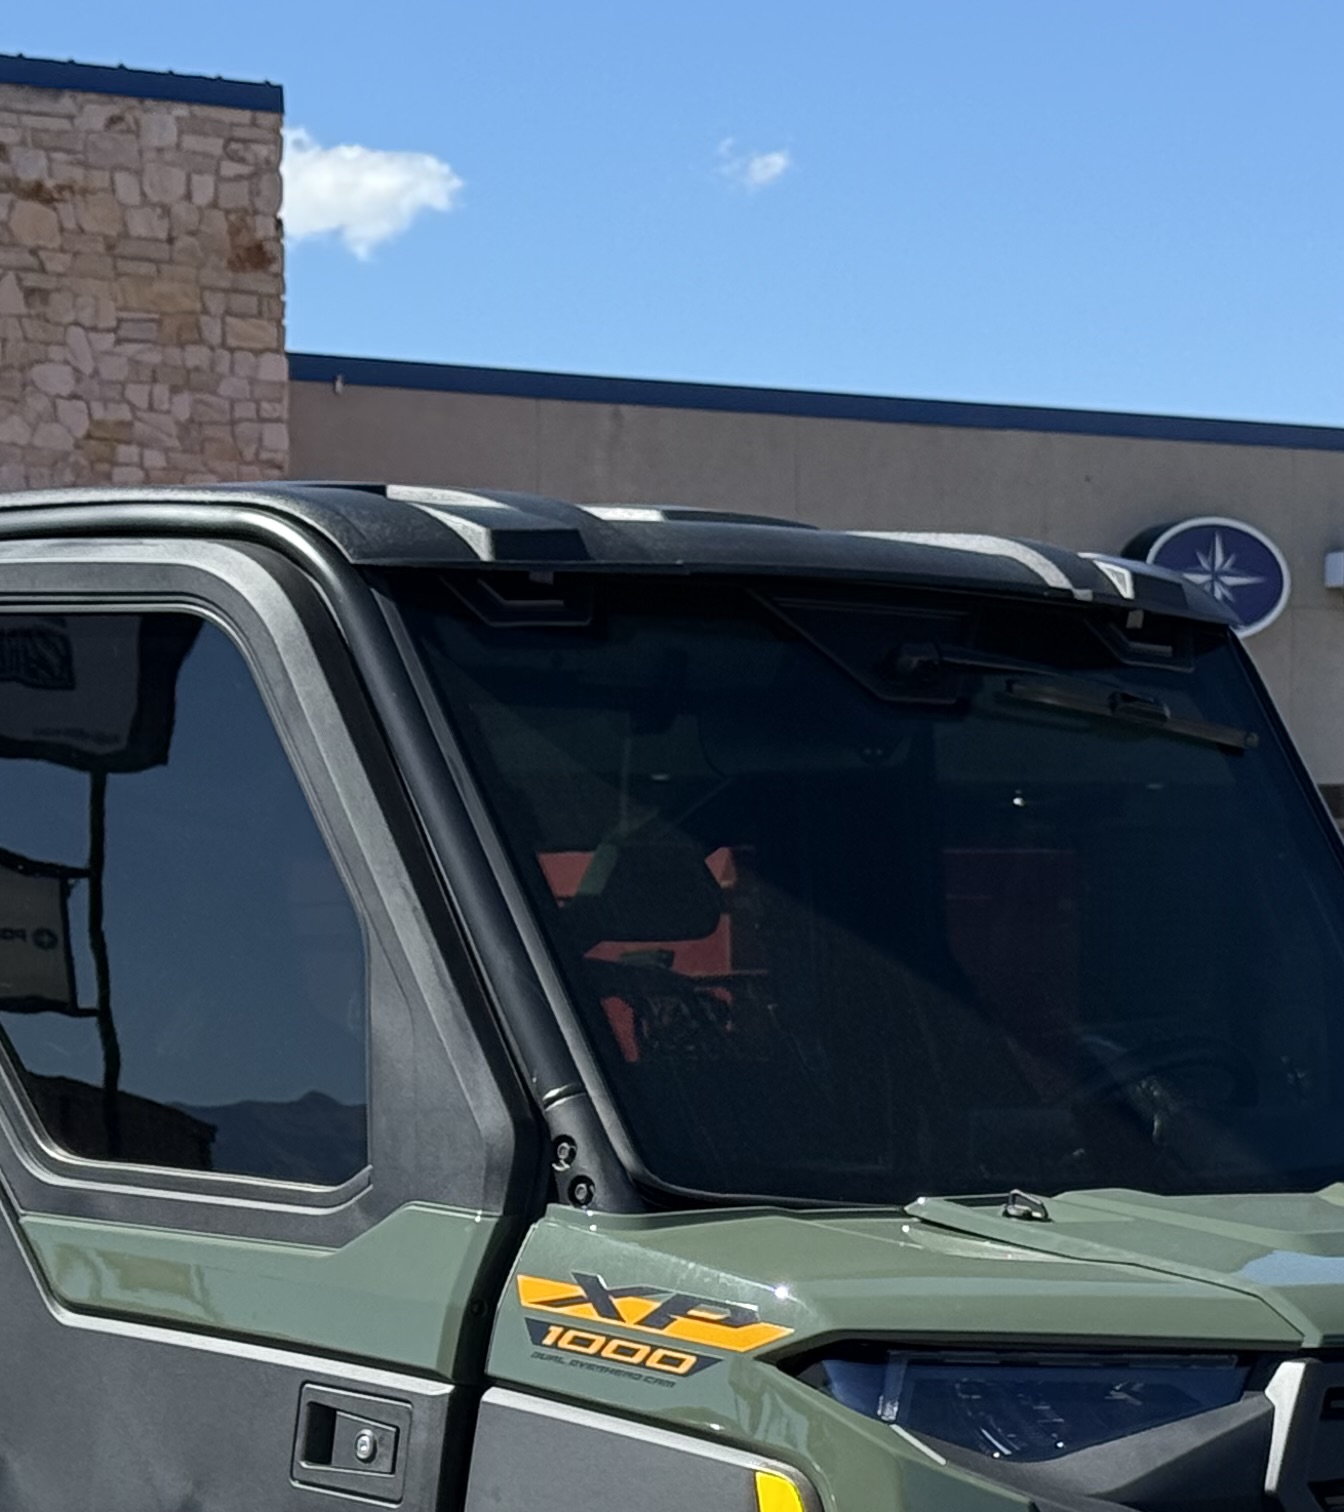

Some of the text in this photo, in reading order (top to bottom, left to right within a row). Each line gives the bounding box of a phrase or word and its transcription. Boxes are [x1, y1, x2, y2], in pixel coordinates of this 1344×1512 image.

[532, 1271, 760, 1330] XP
[530, 1351, 565, 1365] DUAL
[643, 1374, 677, 1389] CAM
[541, 1325, 697, 1375] 1000
